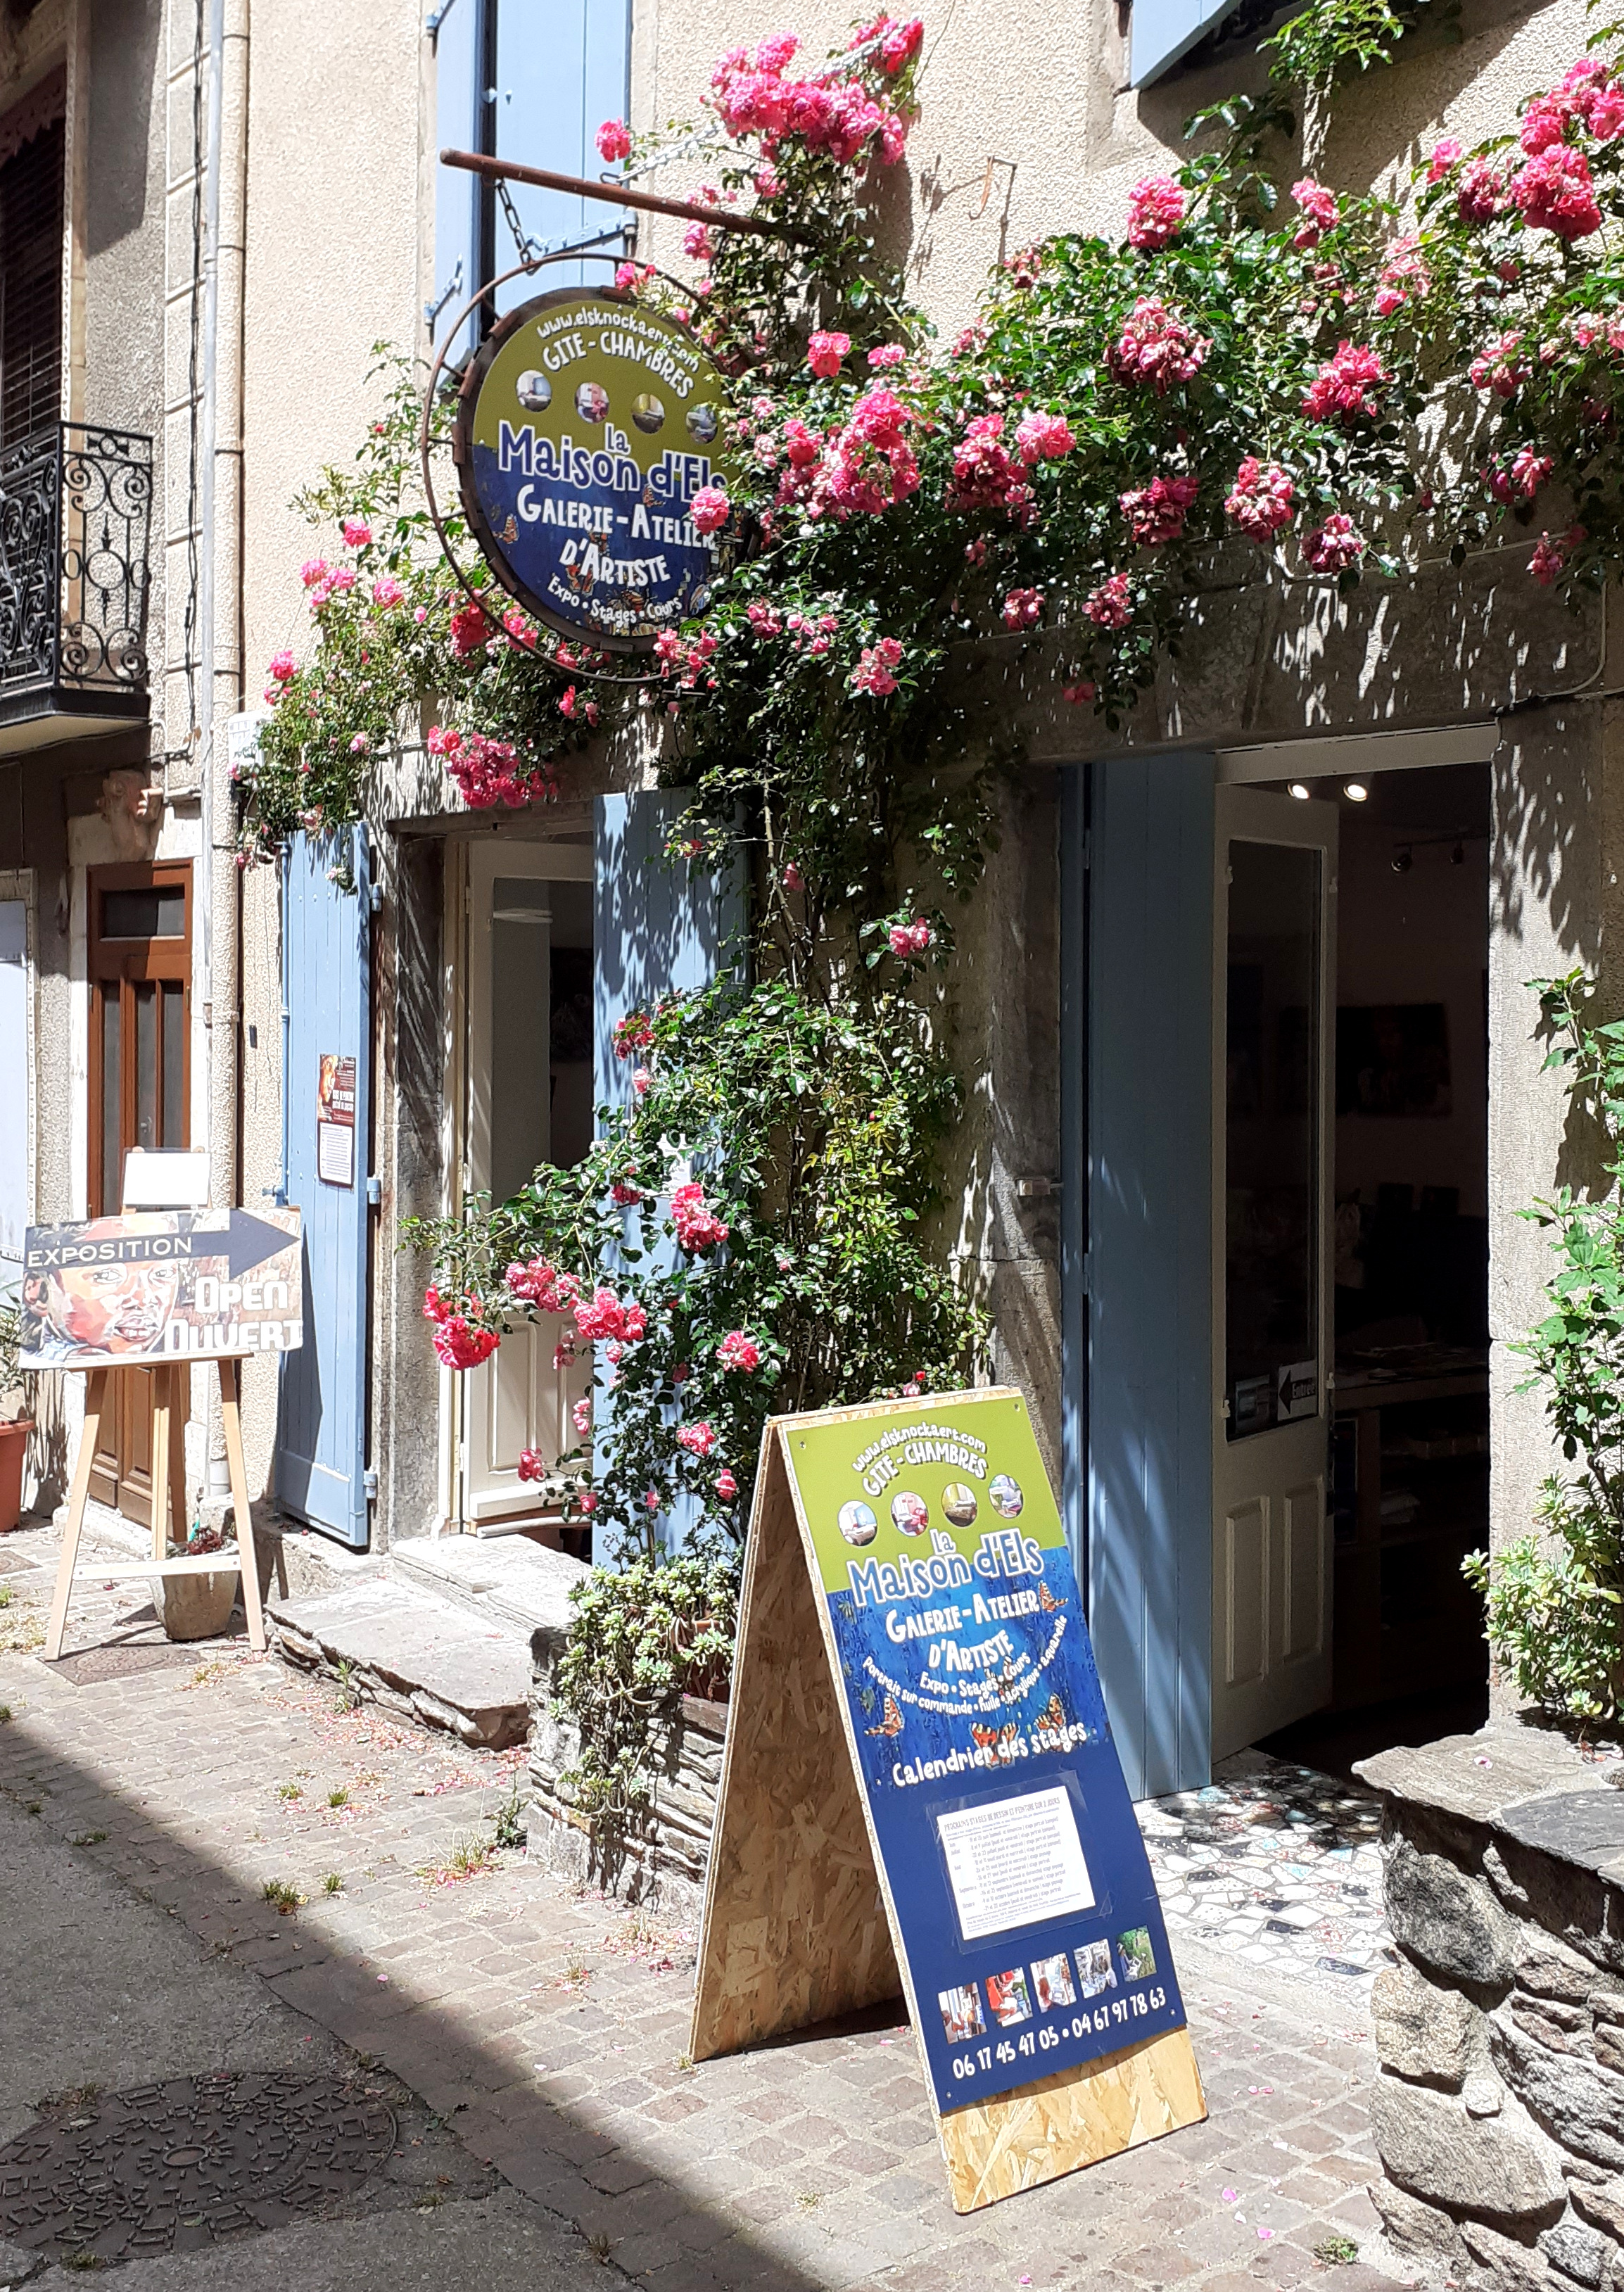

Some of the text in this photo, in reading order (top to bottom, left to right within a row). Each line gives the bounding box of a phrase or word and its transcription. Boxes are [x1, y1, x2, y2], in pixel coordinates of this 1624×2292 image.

[543, 331, 694, 398] GITE CHAMBRES
[498, 419, 640, 491] Maison
[547, 576, 683, 628] Expo Stages Cours
[27, 1236, 191, 1267] EXPOSITION
[852, 1422, 987, 1471] www.elsknockaert.com
[863, 1441, 987, 1496] GITE CHAMBRES
[846, 1528, 1044, 1607] Maison d'Els
[862, 1615, 1067, 1715] Portrait sur commande huile acrylique aquarelle
[920, 1652, 1031, 1699] Expo Stages Cours
[892, 1722, 1086, 1787] Calendrier des stages
[953, 1987, 1166, 2079] 06 17 45 47 05 04 67 97 78 63
